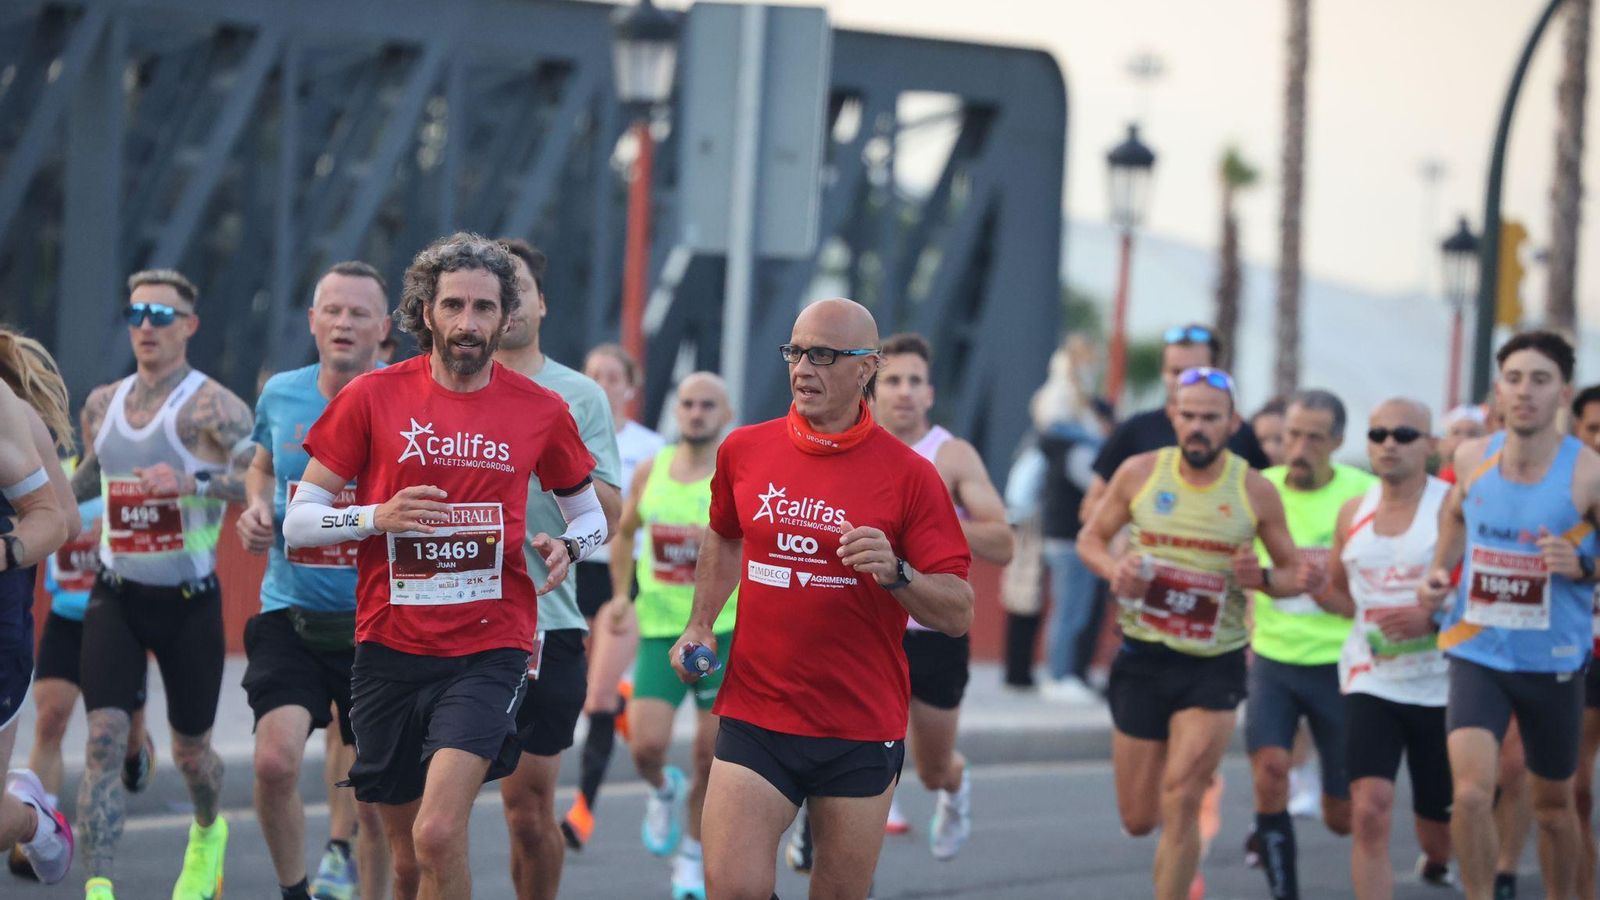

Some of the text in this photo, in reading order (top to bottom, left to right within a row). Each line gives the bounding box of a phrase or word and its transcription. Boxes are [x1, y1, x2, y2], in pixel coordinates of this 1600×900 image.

[426, 432, 510, 461] califas
[776, 497, 846, 525] califas
[413, 541, 479, 560] 13469
[777, 532, 819, 554] UCO
[768, 552, 797, 562] UNIVERSIDAD
[467, 576, 484, 585] 21K
[755, 567, 790, 579] IMDECO
[811, 574, 858, 585] AGRIMENSUR
